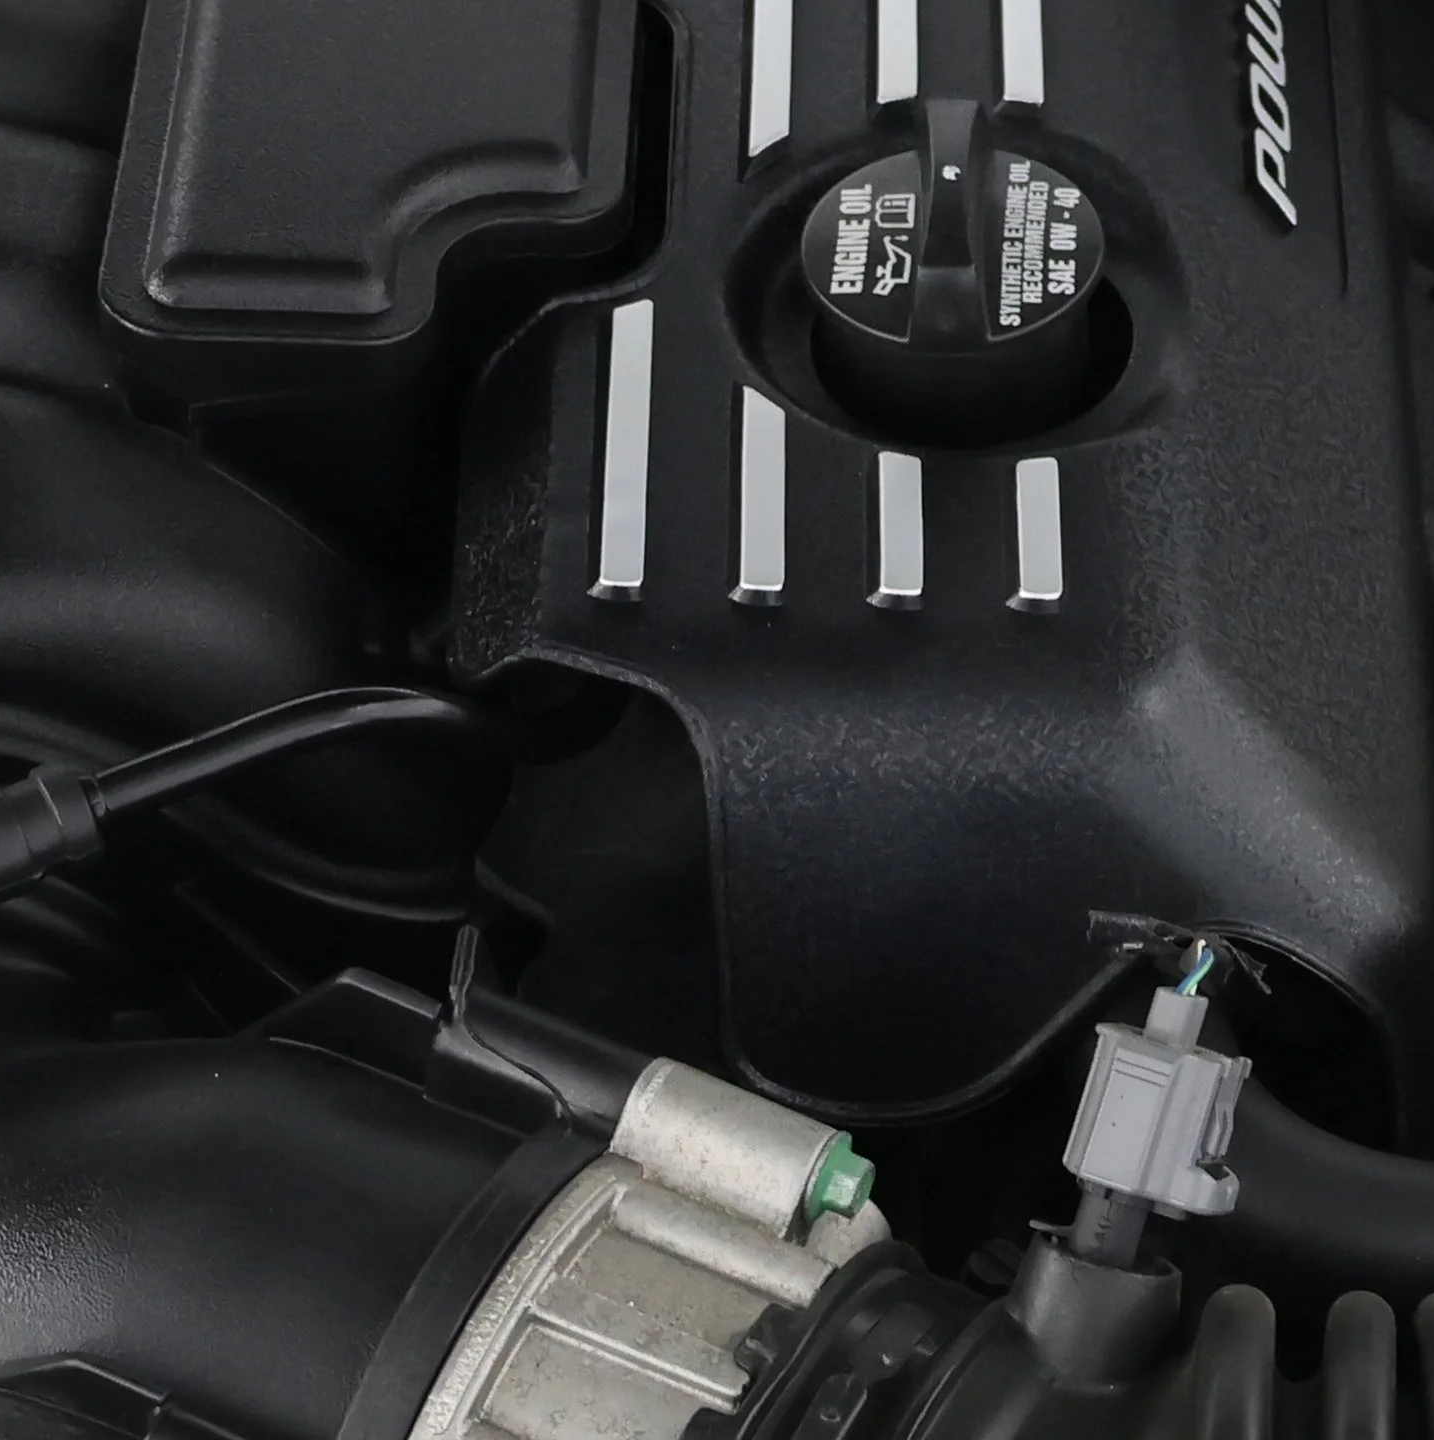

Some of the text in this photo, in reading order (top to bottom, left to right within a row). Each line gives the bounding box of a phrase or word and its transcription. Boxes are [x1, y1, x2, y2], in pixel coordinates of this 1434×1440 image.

[829, 183, 873, 295] ENGINE OIL
[998, 159, 1031, 327] SYNTHETIC ENGINE OIL
[1022, 180, 1049, 304] RECOMMENDED
[1047, 258, 1077, 296] SAE
